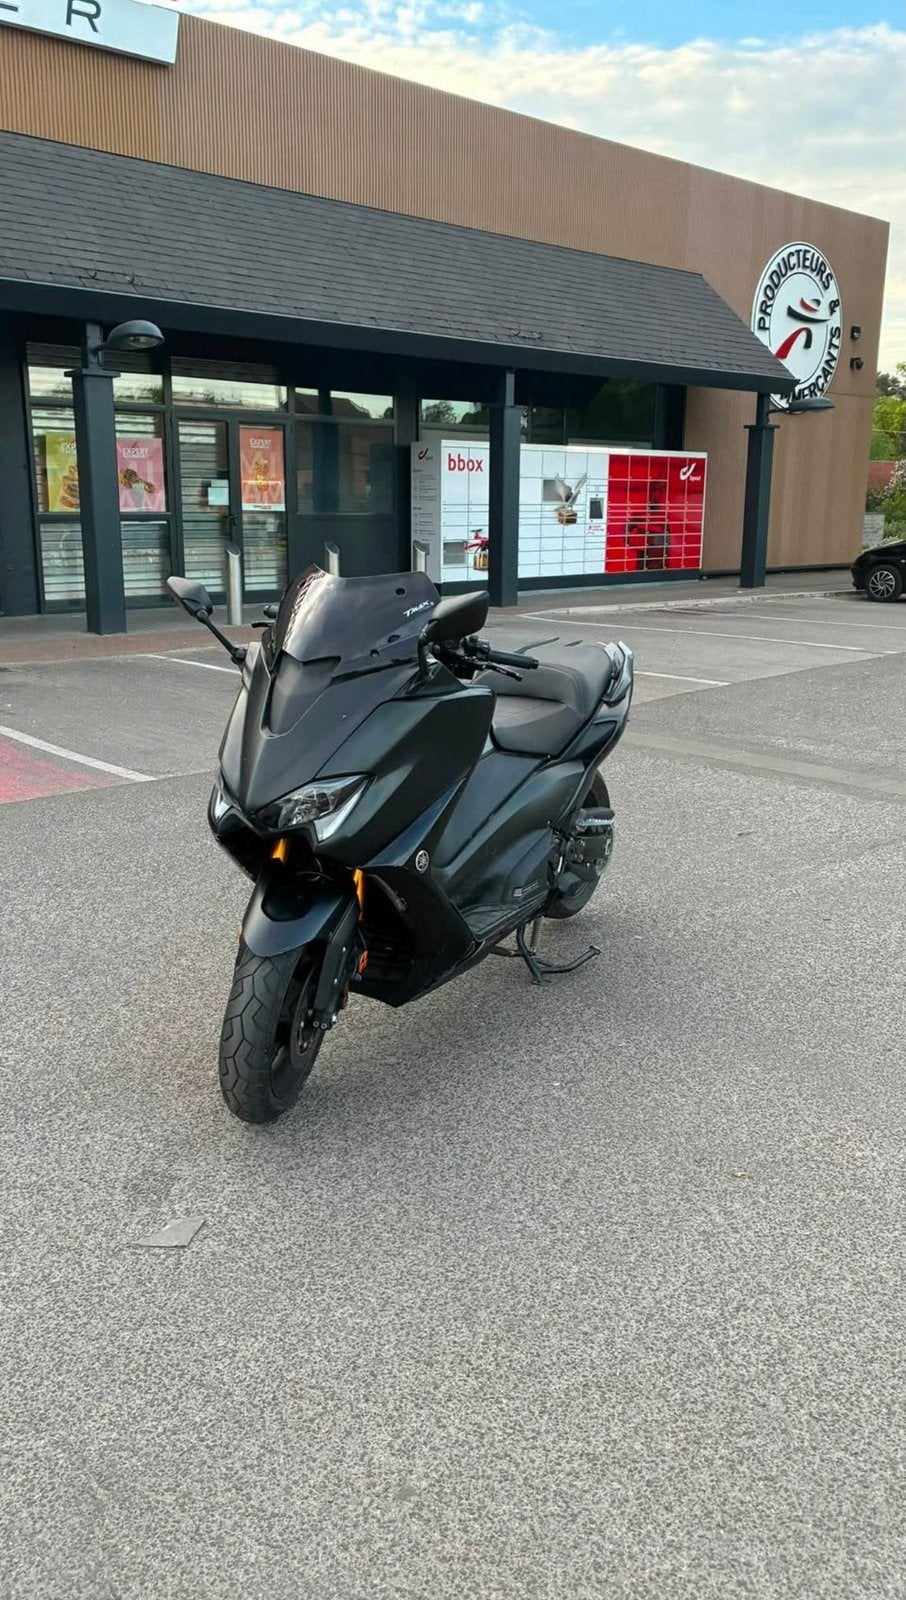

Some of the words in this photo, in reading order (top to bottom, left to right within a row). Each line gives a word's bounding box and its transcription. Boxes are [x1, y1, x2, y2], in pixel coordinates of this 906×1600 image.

[757, 249, 832, 331] PRODUCTEURS
[829, 299, 840, 317] &
[447, 452, 484, 473] bbox
